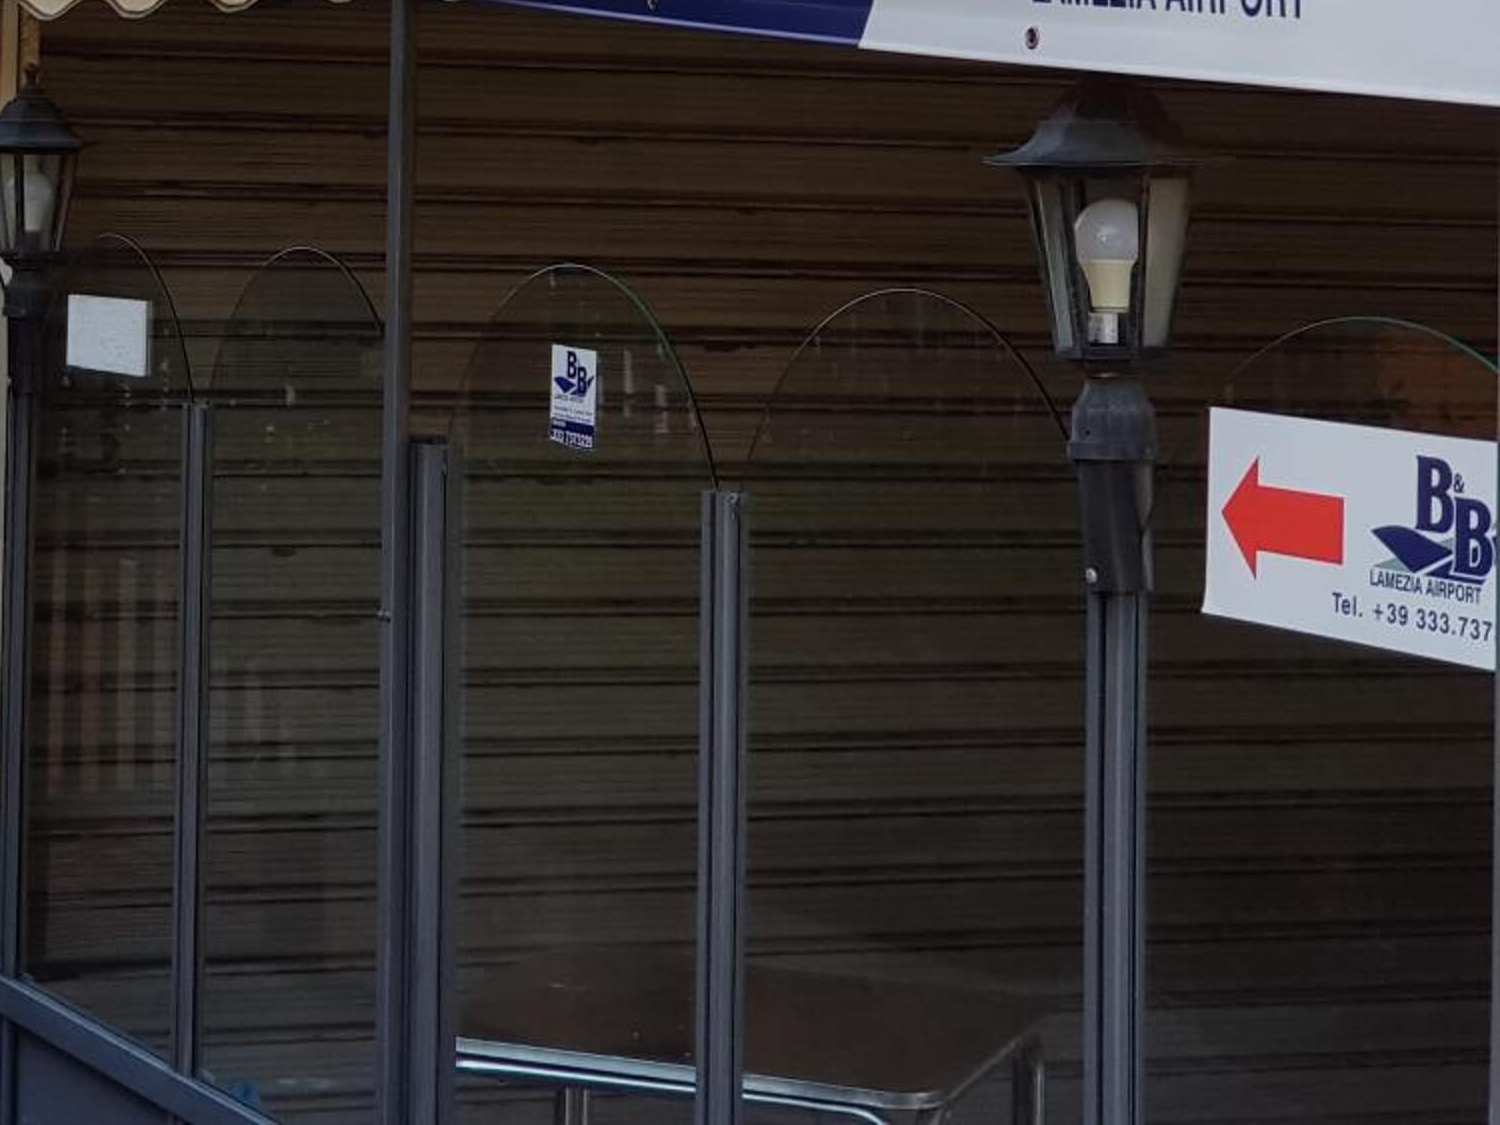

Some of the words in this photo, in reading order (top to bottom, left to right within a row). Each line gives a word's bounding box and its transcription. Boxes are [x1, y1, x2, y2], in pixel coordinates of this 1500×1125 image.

[1369, 569, 1423, 595] LAMEZIA
[1425, 578, 1482, 604] AIRPORT
[1332, 592, 1363, 618] Tel.
[1373, 602, 1409, 626] +39
[1416, 608, 1493, 642] 333.737
